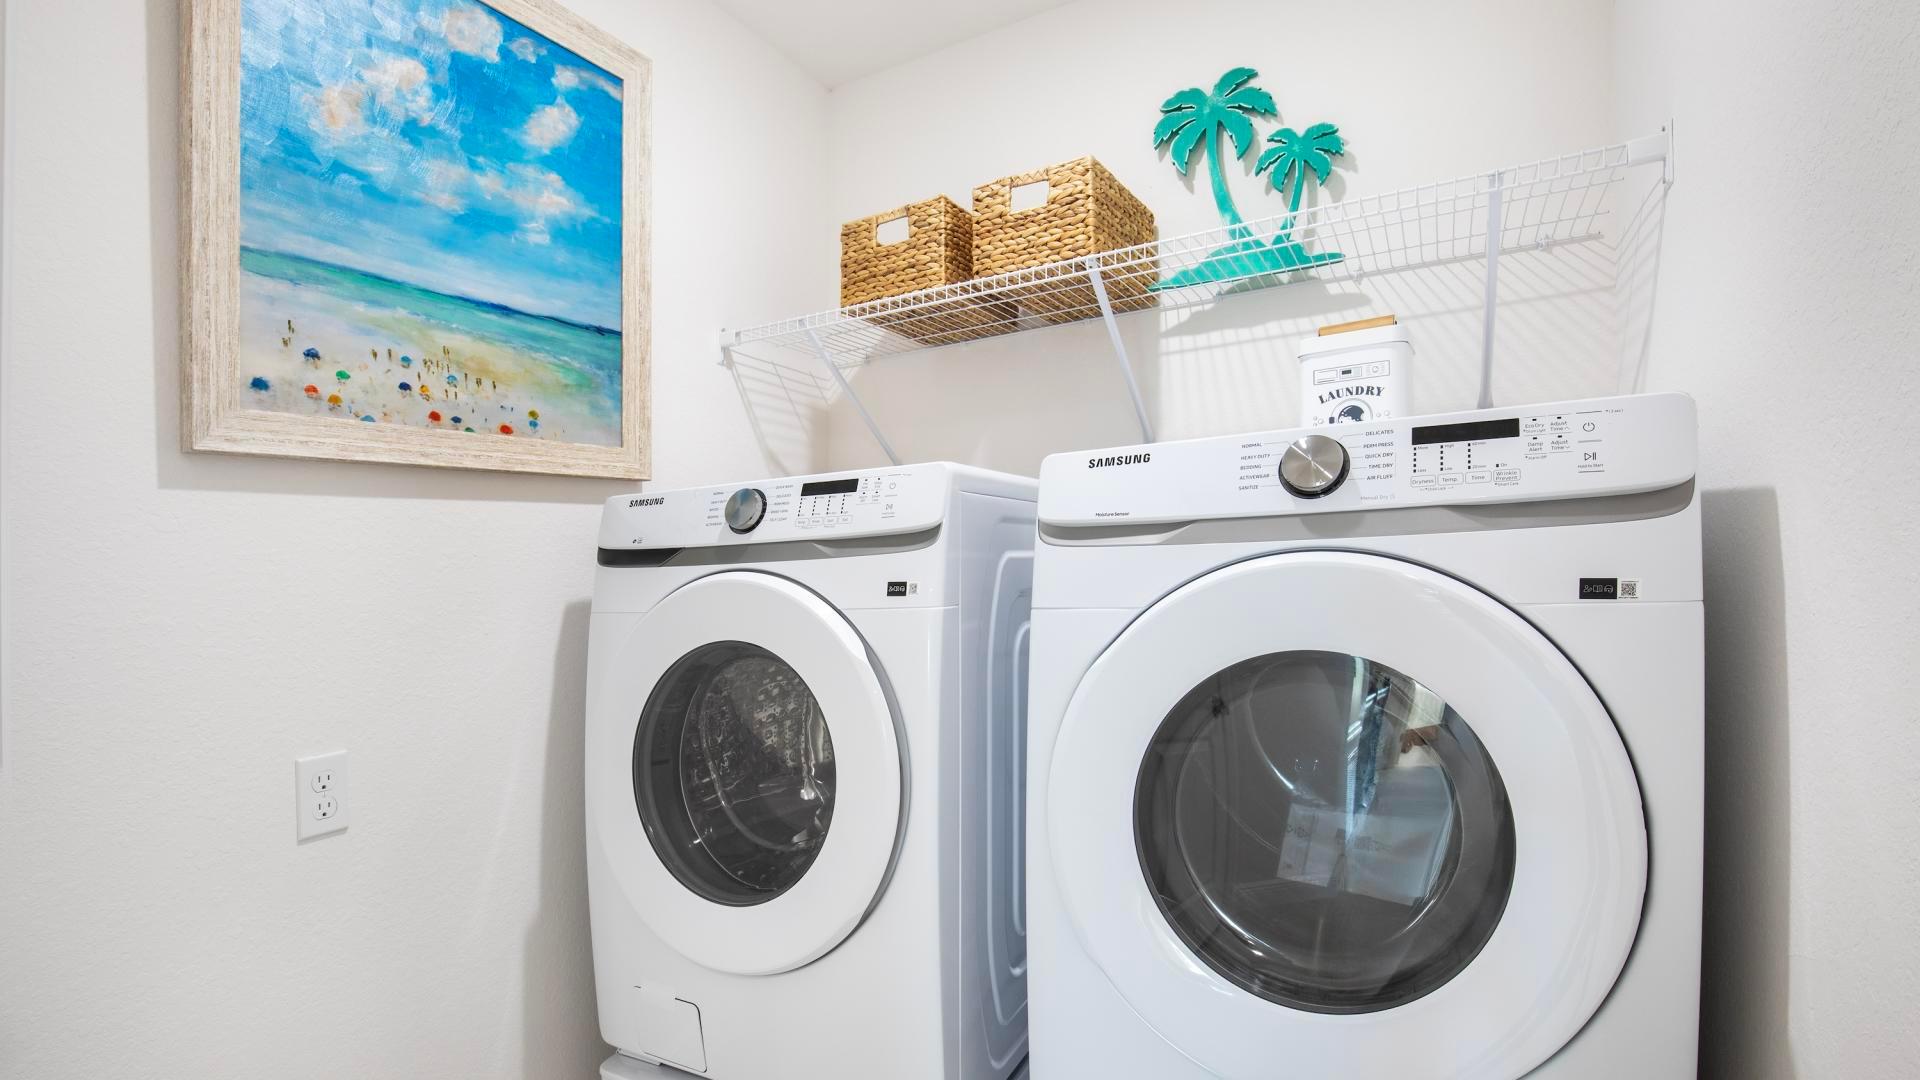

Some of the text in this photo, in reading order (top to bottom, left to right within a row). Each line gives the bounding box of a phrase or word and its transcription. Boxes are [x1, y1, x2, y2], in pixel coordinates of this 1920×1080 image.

[1318, 385, 1385, 404] LAUNDRY
[1088, 453, 1151, 468] SAMSUNG
[629, 497, 664, 507] SAMSUNG
